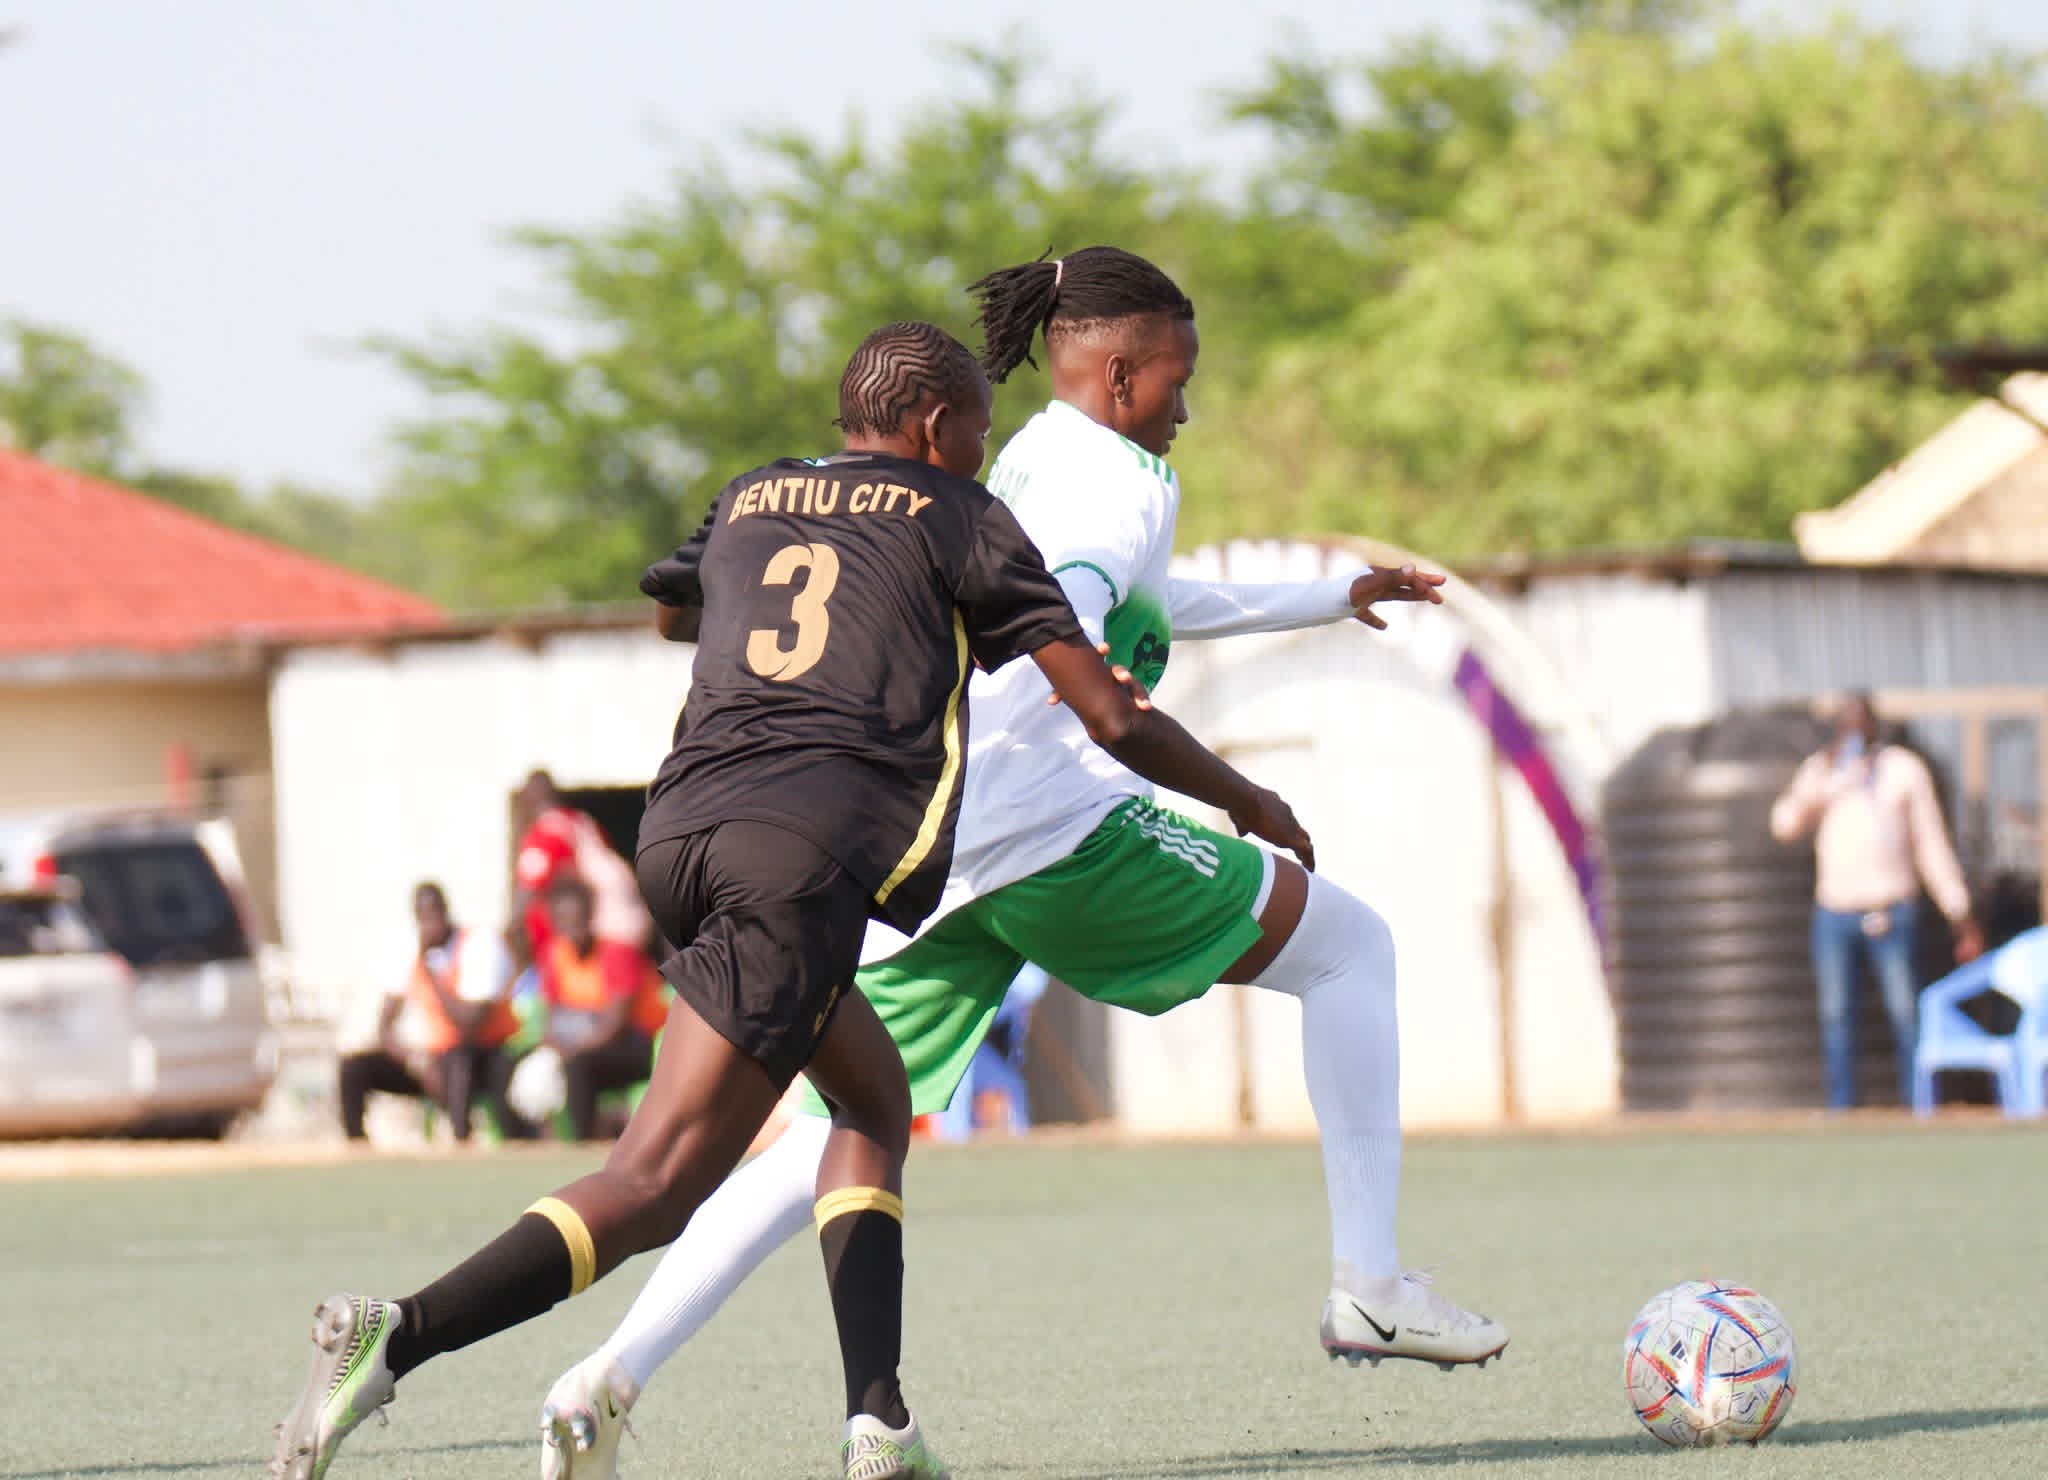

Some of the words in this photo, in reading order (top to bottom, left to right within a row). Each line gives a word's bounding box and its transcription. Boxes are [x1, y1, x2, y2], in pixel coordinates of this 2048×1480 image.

[728, 477, 841, 525] BENTIU
[848, 483, 933, 517] CITY
[746, 543, 840, 682] 3
